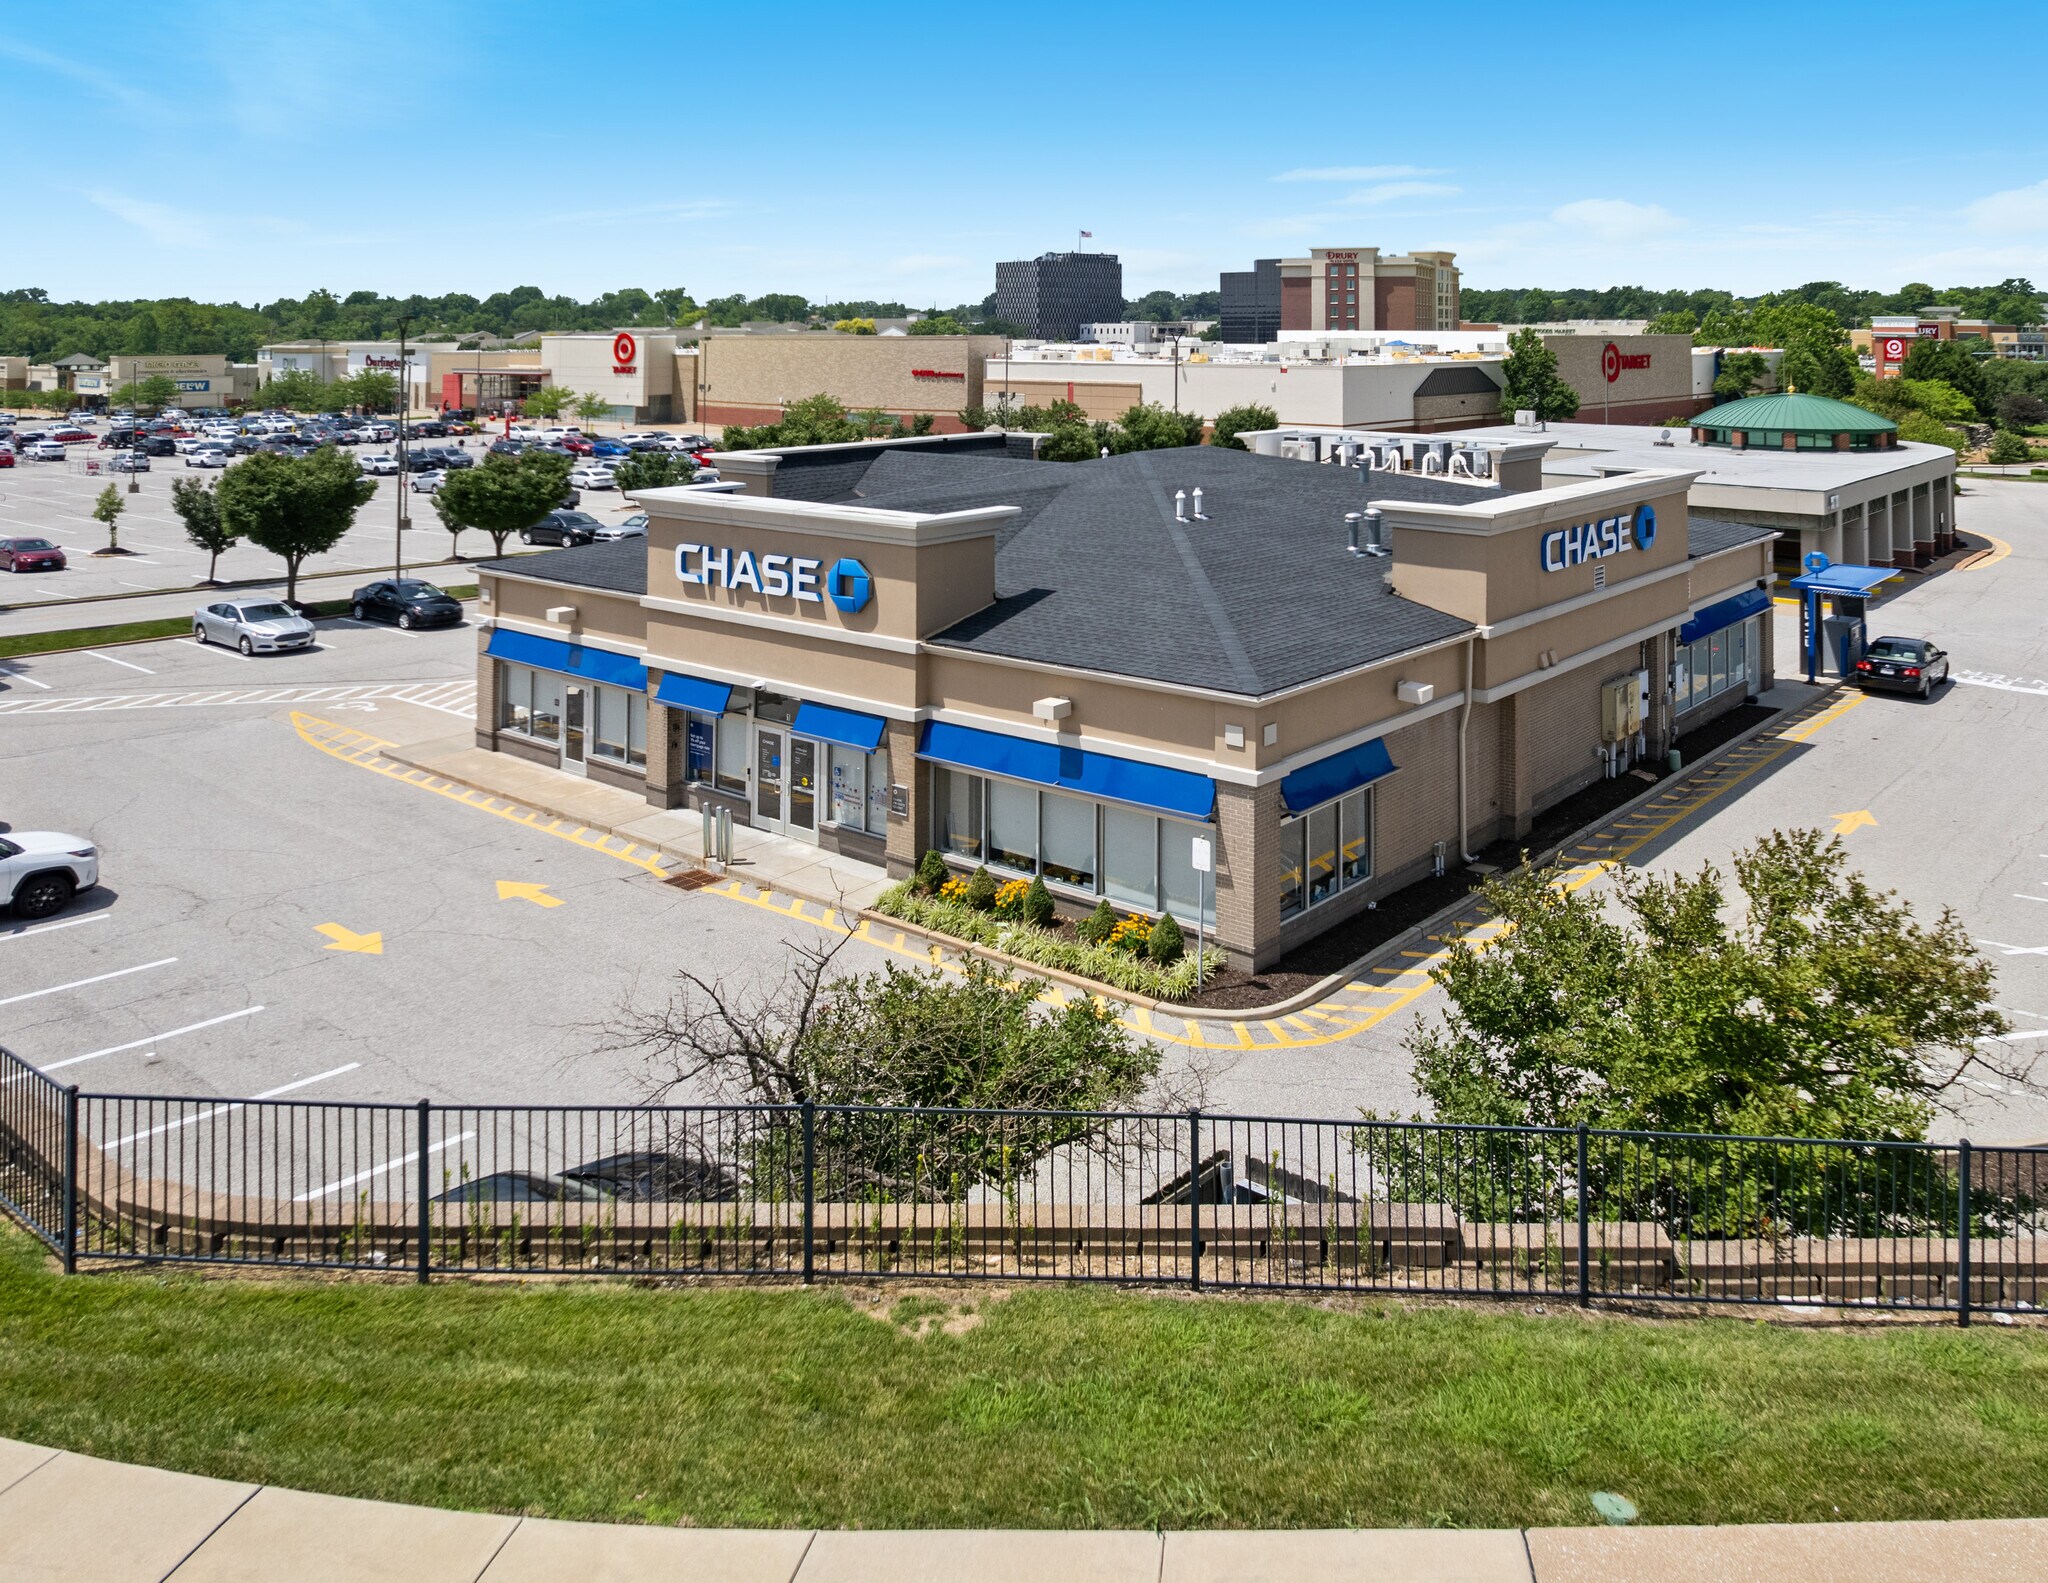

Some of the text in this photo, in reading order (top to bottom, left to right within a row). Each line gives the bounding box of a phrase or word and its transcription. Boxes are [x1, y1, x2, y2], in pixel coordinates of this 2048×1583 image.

[1325, 251, 1358, 259] DRURY
[366, 354, 406, 368] Burlingto
[1620, 354, 1651, 369] TARGET
[1542, 514, 1633, 572] CHASE
[674, 543, 823, 602] CHASE
